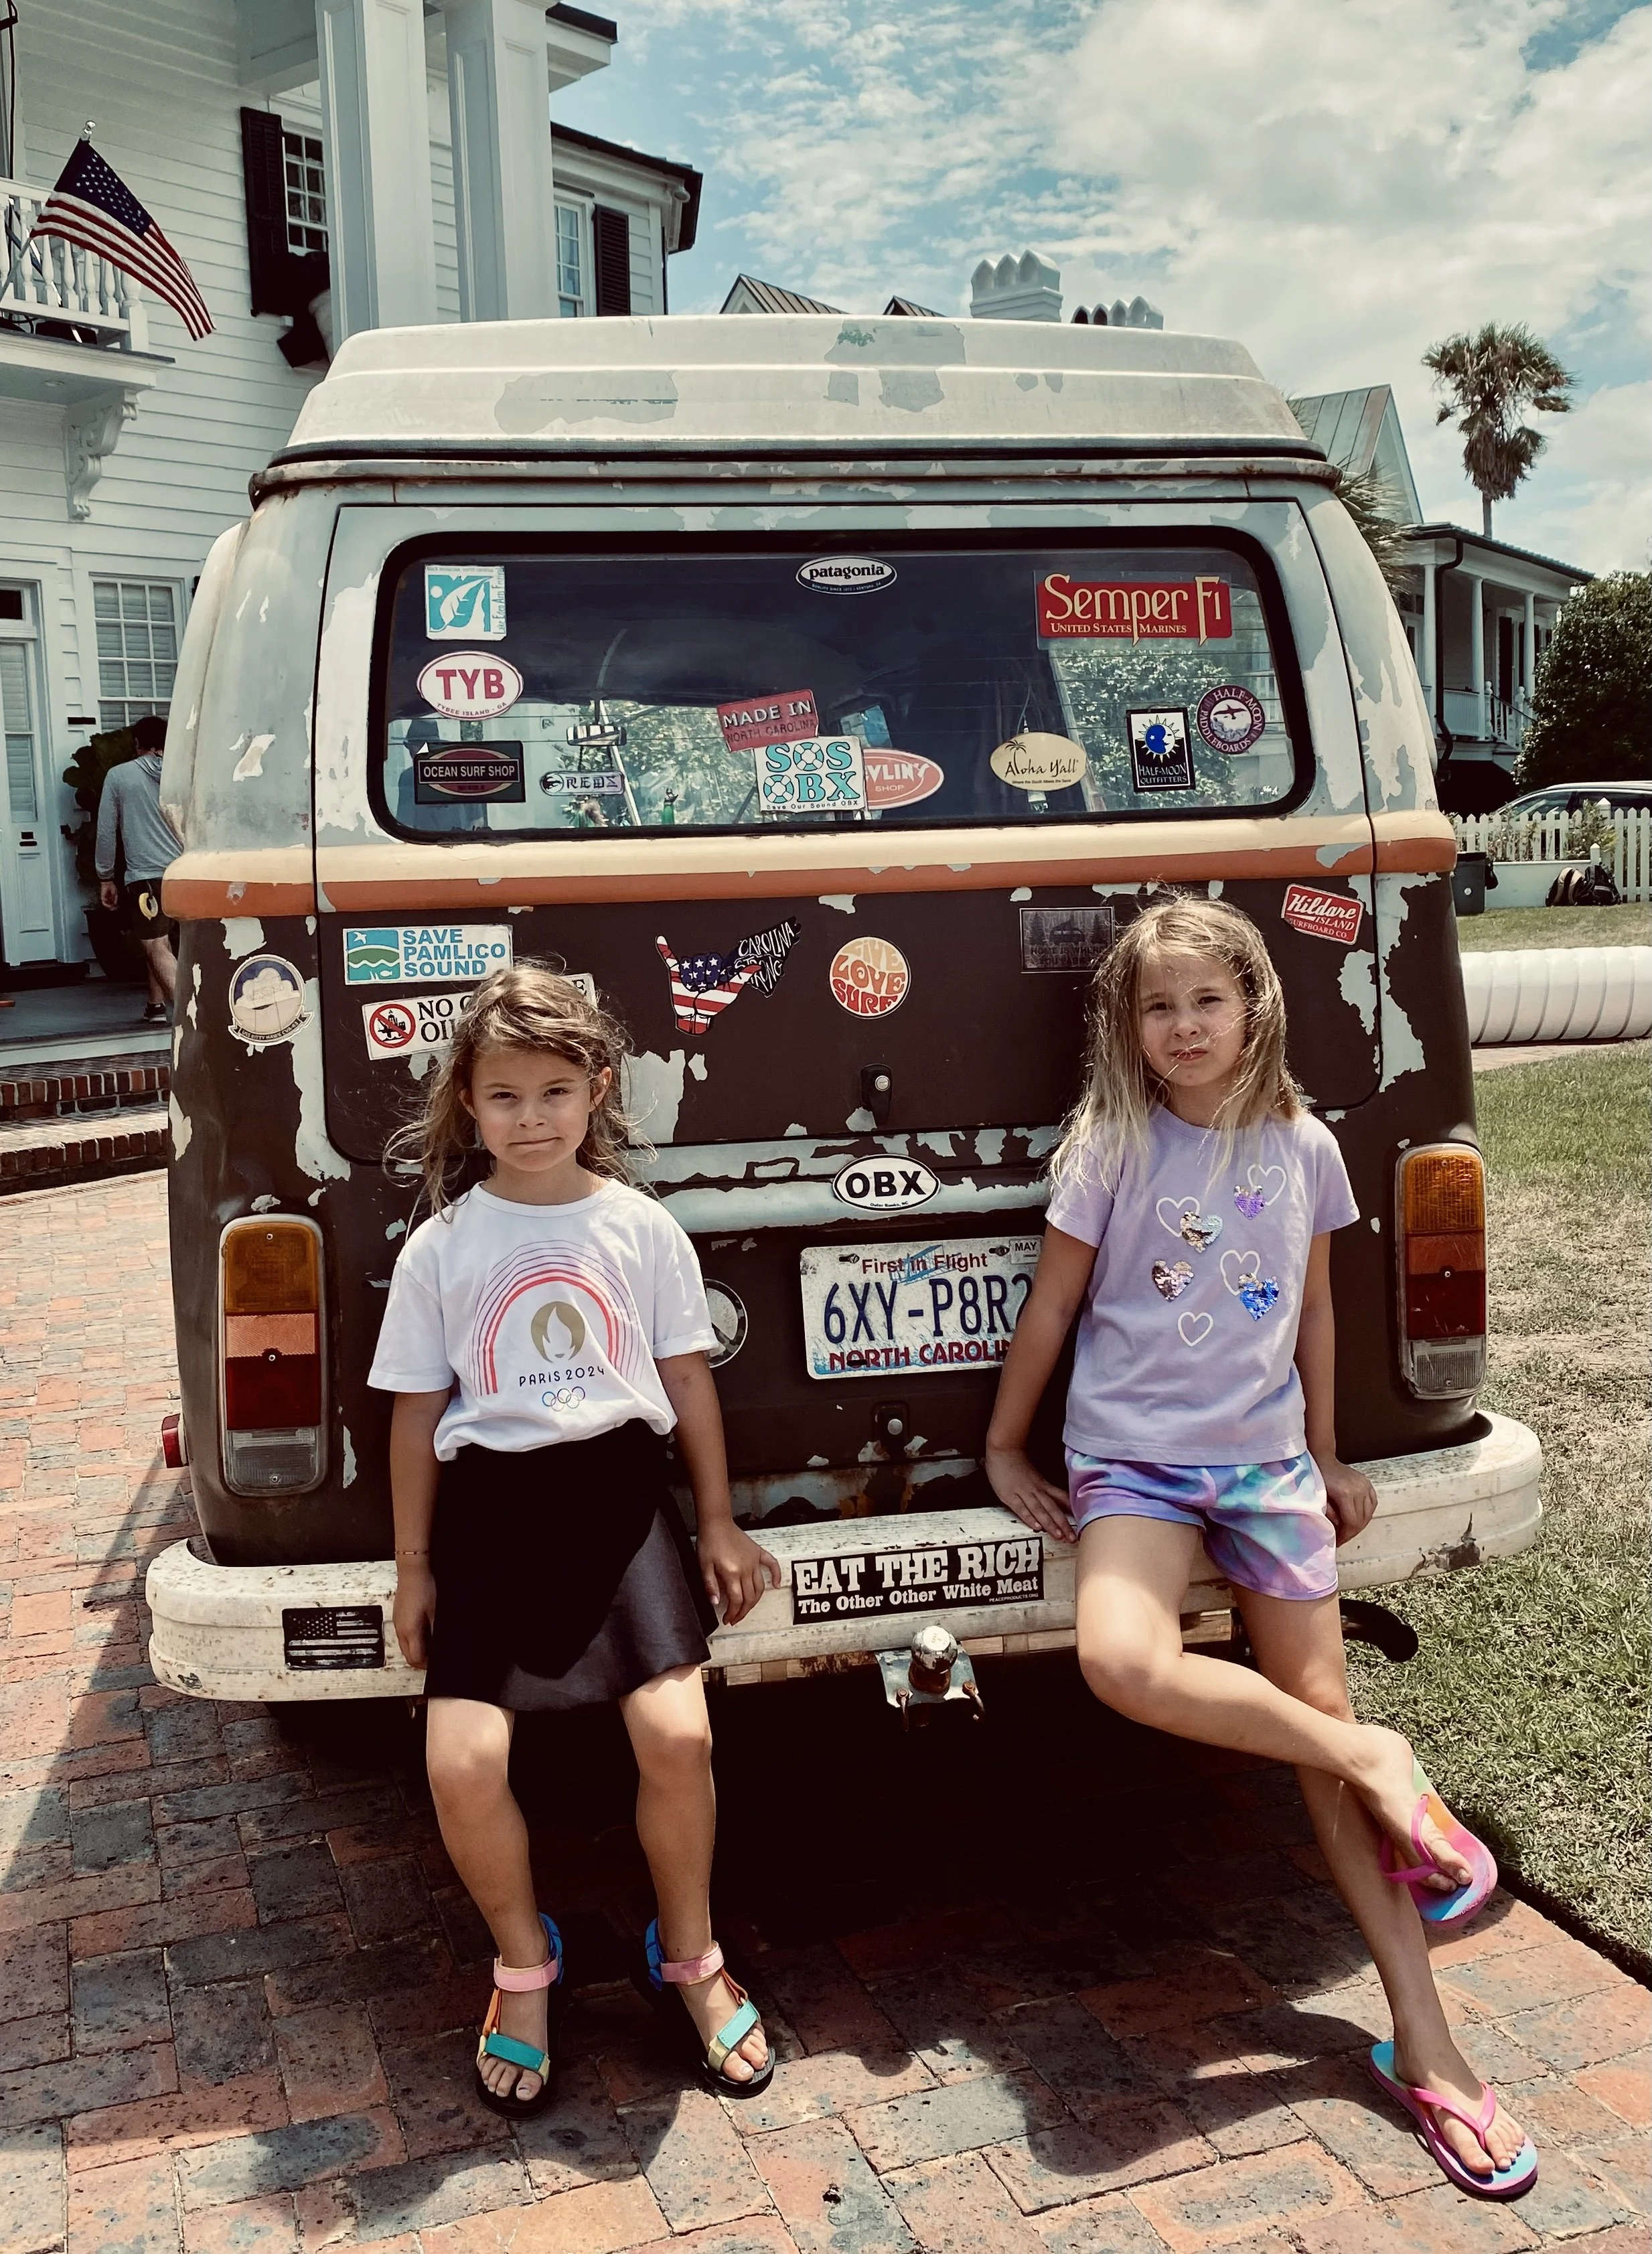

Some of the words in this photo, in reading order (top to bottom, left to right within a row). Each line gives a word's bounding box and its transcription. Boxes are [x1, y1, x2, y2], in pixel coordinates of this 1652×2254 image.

[809, 564, 885, 580] patagonia
[1044, 574, 1189, 647] Semper
[1195, 576, 1221, 646] Fi
[1051, 623, 1090, 633] UNITED
[1093, 623, 1132, 633] STATES
[1140, 623, 1187, 633] MARINES
[435, 668, 505, 700] TYB
[437, 702, 460, 715] TYBEE
[723, 704, 781, 729] MADE
[787, 699, 812, 717] IN
[1213, 688, 1263, 731] HALF-MOON
[727, 729, 761, 743] NORTH
[765, 719, 816, 735] CAROLINA
[1199, 710, 1251, 752] PADDLEBOARDS
[765, 741, 852, 773] SOS
[1004, 749, 1047, 777] Aloha
[423, 765, 457, 777] OCEAN
[460, 765, 486, 777] SURF
[488, 765, 515, 776] SHOP
[865, 763, 930, 783] VLIN'S
[1138, 762, 1187, 776] HALF-MOON
[1140, 775, 1187, 785] OUTFITTERS
[763, 771, 860, 804] OBX
[875, 784, 905, 792] SHOP
[1286, 893, 1357, 919] Kildare
[1289, 918, 1335, 935] SURFBOARD
[1313, 916, 1355, 931] ISLAND
[403, 928, 463, 945] SAVE
[738, 921, 795, 957] CAROLINA
[403, 944, 506, 961] PAMLICO
[404, 960, 486, 977] SOUND
[832, 954, 905, 995] LOVE
[832, 978, 898, 1014] SURF
[417, 998, 453, 1021] NO
[845, 1171, 927, 1199] OBX
[1015, 1242, 1037, 1252] MAY
[862, 1258, 905, 1274] First
[910, 1256, 927, 1271] in
[934, 1253, 988, 1272] Flight
[830, 1347, 912, 1371] NORTH
[519, 1371, 560, 1387] PARIS
[566, 1365, 605, 1380] 2024
[794, 1557, 865, 1596] EAT
[875, 1549, 948, 1588] THE
[958, 1539, 1040, 1580] RICH
[798, 1598, 830, 1614] The
[836, 1592, 883, 1610] Other
[889, 1589, 936, 1605] Other
[942, 1582, 991, 1600] White
[996, 1576, 1038, 1594] Meat
